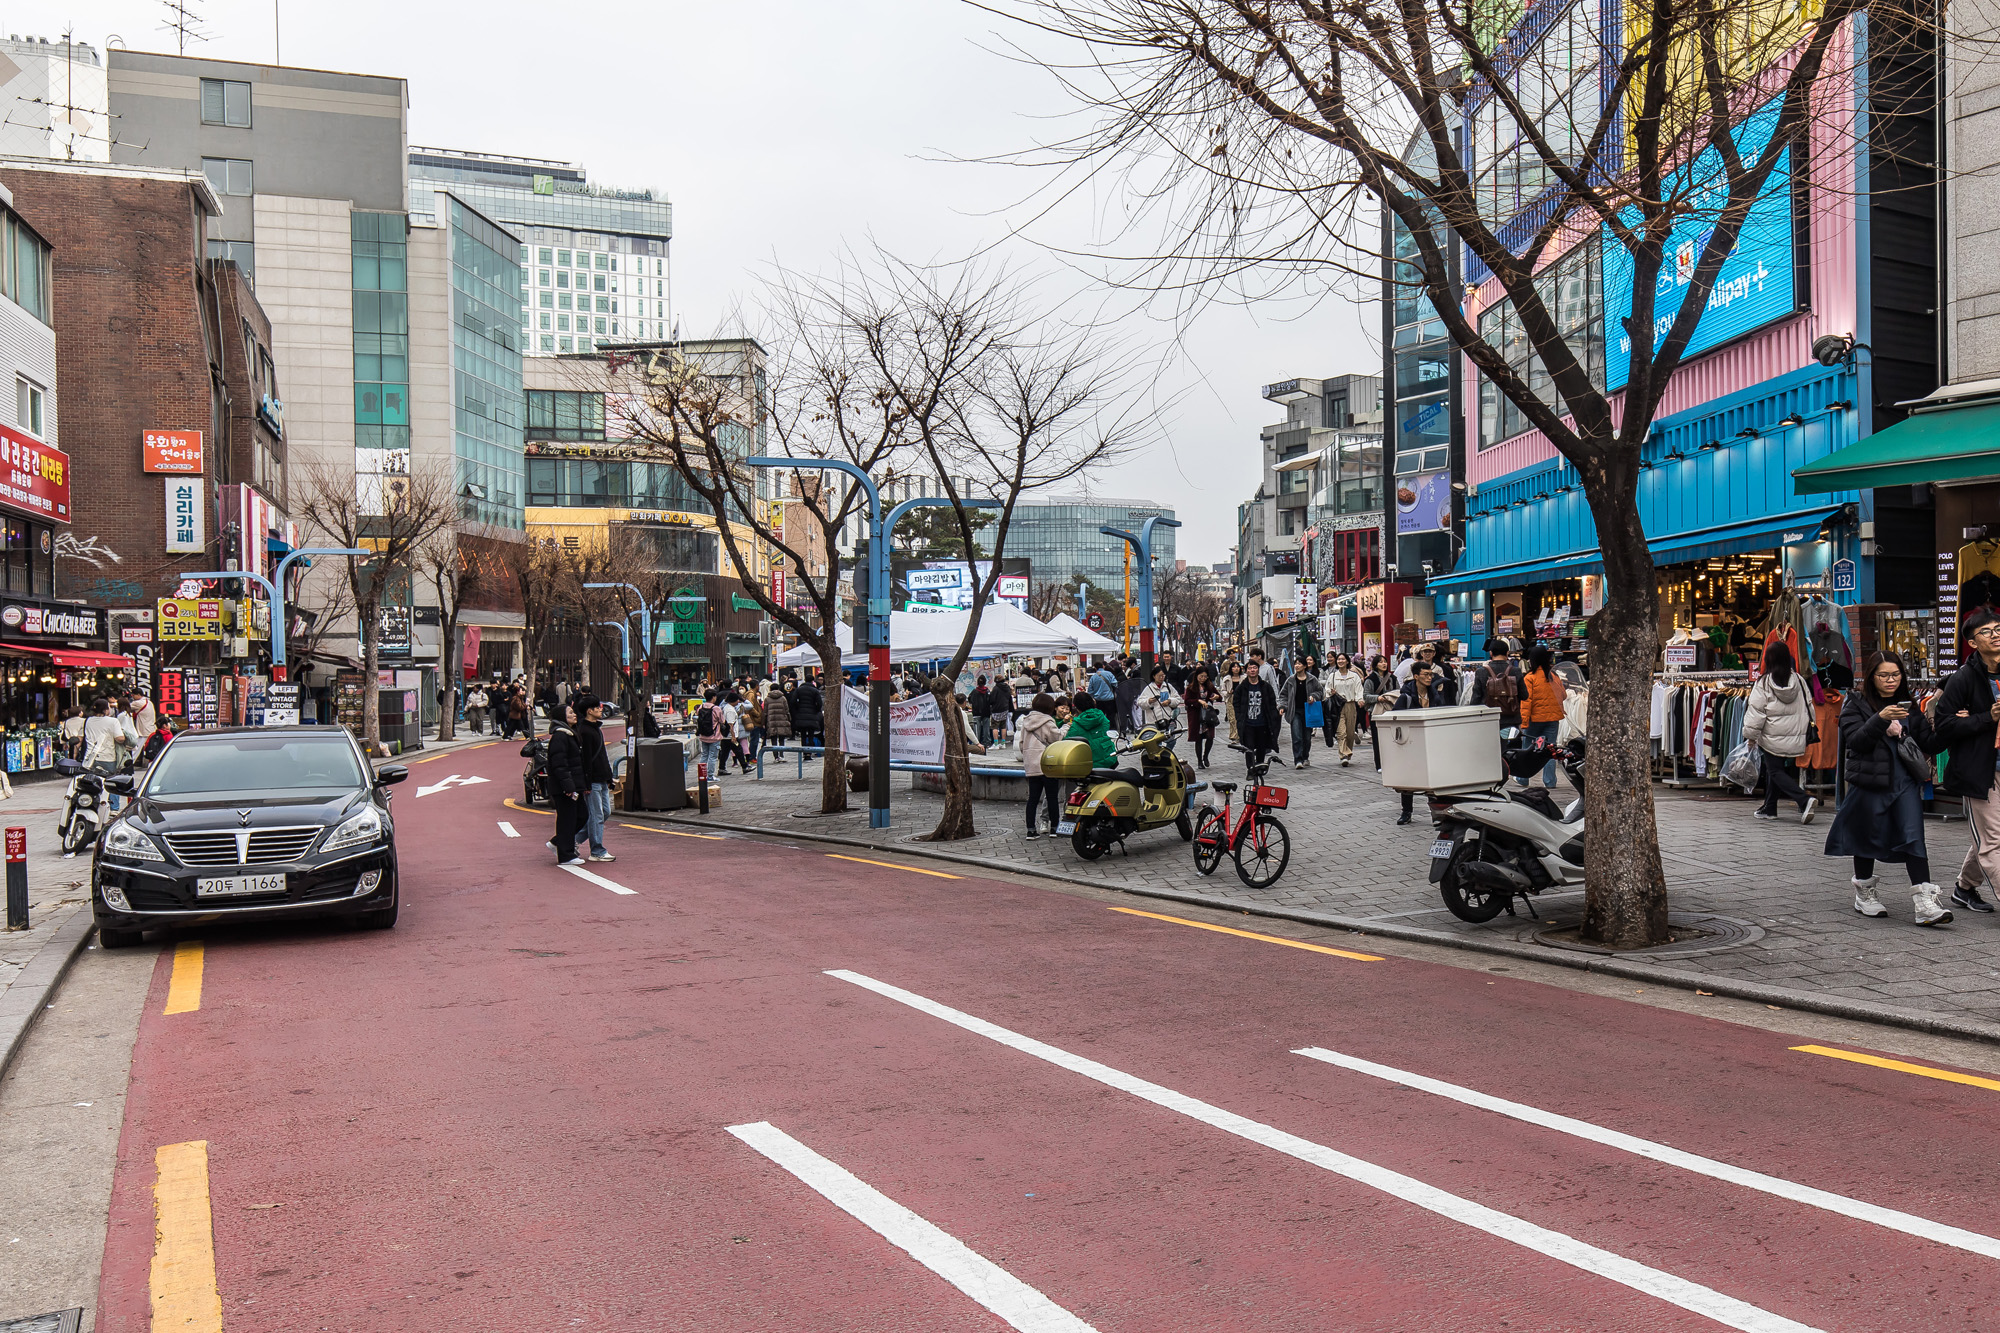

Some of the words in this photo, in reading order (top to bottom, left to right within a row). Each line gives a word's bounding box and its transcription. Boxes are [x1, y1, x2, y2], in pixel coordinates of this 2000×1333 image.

[176, 485, 194, 543] 심리카페
[914, 573, 949, 584] 마약김밥
[1837, 574, 1851, 587] 132
[182, 584, 199, 594] 코인
[1006, 582, 1024, 592] 마약
[163, 621, 221, 635] 코인노래
[1090, 620, 1100, 628] R2
[137, 645, 153, 700] CHICKE
[159, 673, 182, 716] BBQ
[205, 879, 233, 893] 20두
[241, 875, 278, 891] 1166
